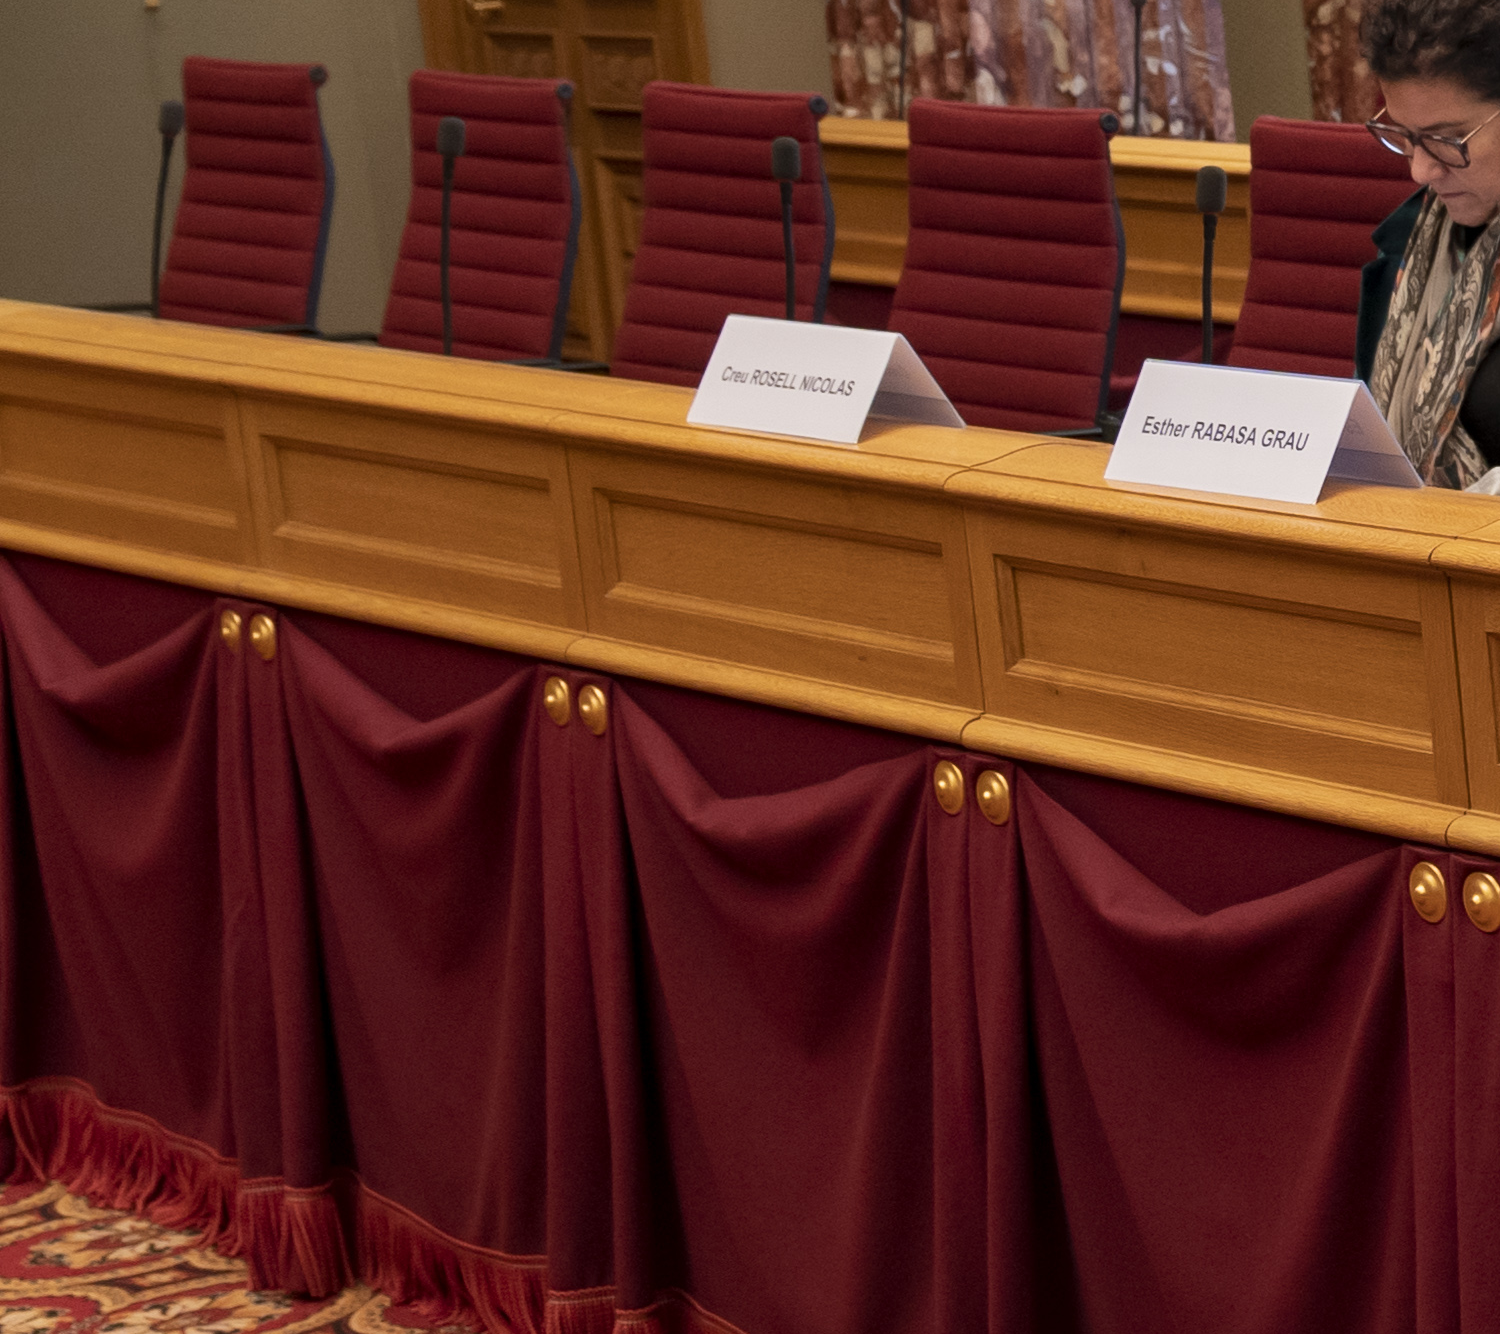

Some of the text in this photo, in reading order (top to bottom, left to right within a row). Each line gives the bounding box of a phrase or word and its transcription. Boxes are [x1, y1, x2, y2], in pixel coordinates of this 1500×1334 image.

[722, 366, 855, 396] Creu ROSELL NICOLAS
[1142, 416, 1309, 451] Esther RABASA GRAU
